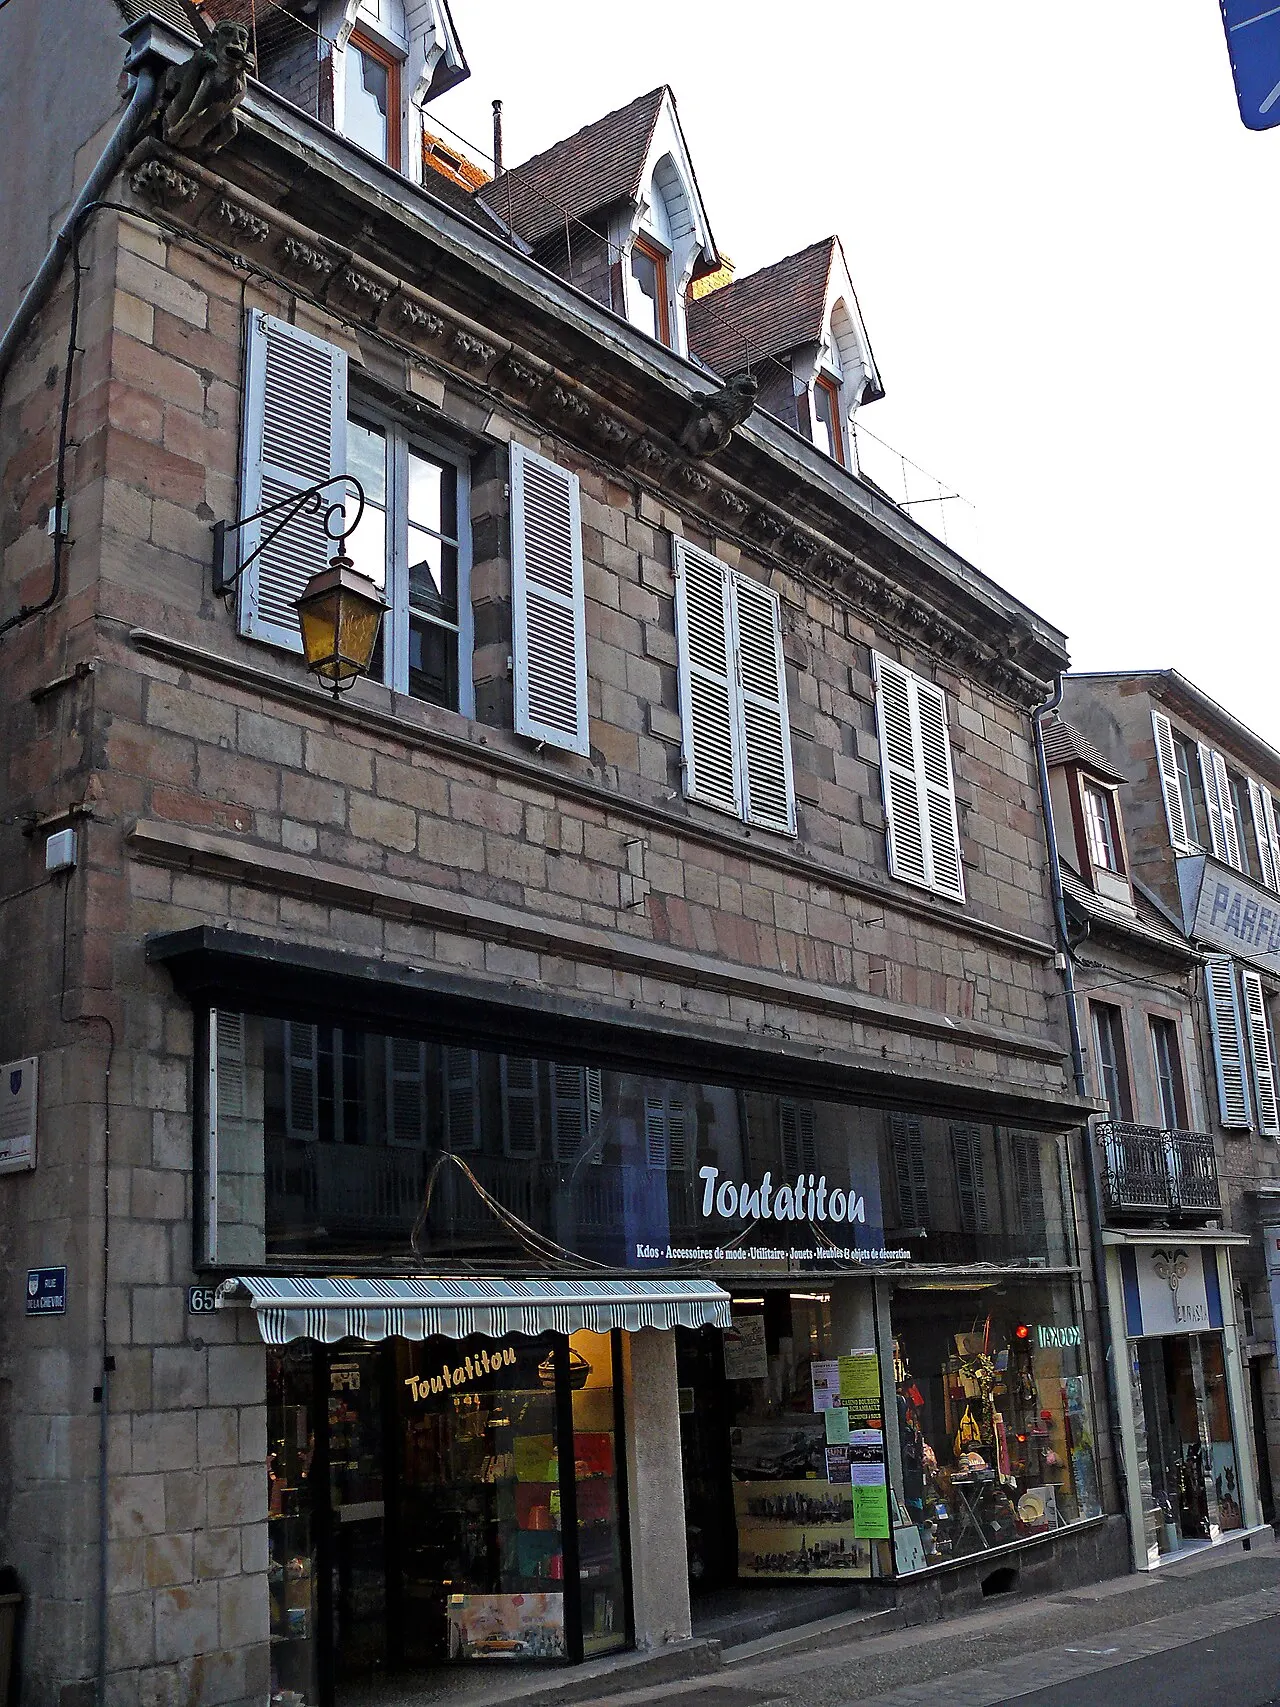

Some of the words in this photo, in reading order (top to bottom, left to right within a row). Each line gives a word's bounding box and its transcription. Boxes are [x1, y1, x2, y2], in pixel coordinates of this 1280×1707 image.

[636, 1244, 659, 1259] Kdos
[665, 1244, 713, 1260] Accessoires
[714, 1246, 724, 1260] de
[725, 1247, 747, 1260] mode
[750, 1247, 785, 1260] Utilitaire
[789, 1247, 813, 1260] Jouets
[816, 1246, 844, 1260] Meubles
[850, 1247, 870, 1261] objets
[870, 1247, 879, 1260] de
[192, 1290, 214, 1311] 65
[404, 1347, 517, 1402] Toutatitou
